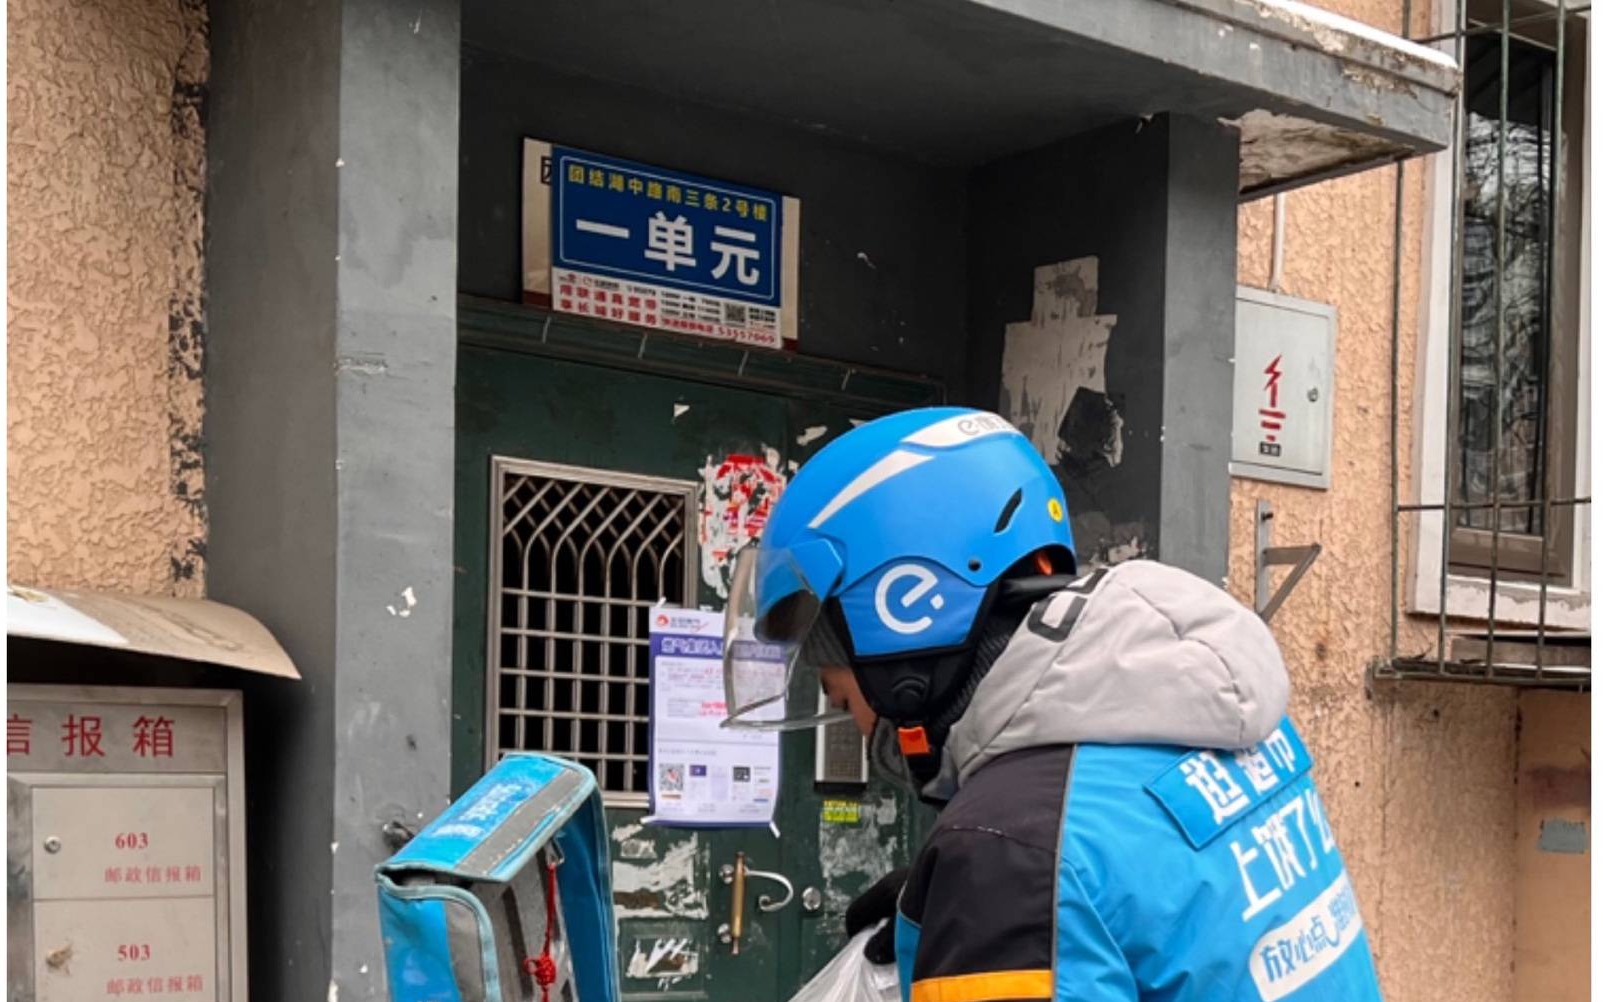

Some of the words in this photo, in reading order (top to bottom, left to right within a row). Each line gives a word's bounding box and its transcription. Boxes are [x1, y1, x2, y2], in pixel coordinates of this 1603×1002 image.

[567, 163, 768, 222] 团结湖中路南三条2号楼
[575, 211, 761, 286] 一单元
[6, 714, 176, 759] 信报箱
[114, 832, 150, 850] 603
[104, 863, 202, 884] 邮政信报箱
[117, 944, 152, 962] 503
[106, 973, 204, 995] 邮政信报箱
